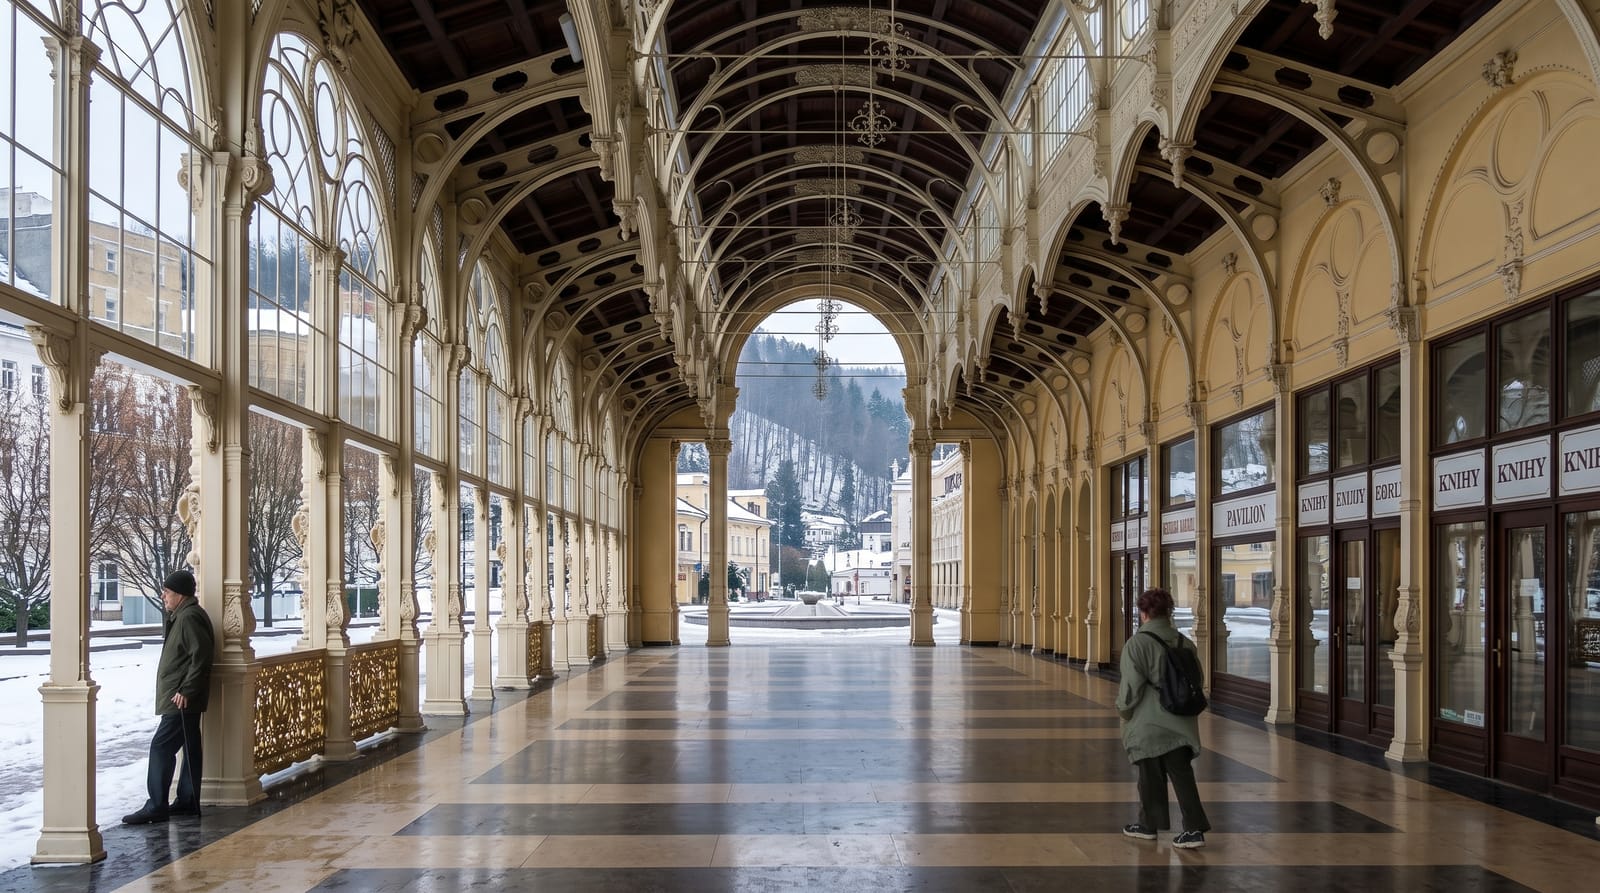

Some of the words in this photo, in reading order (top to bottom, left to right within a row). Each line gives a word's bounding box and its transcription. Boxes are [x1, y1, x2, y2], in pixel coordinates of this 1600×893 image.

[1439, 468, 1481, 492] KNIHY
[1497, 456, 1546, 484] KNIHY
[1226, 503, 1266, 528] PAVILION
[1301, 495, 1328, 513] KNIHY
